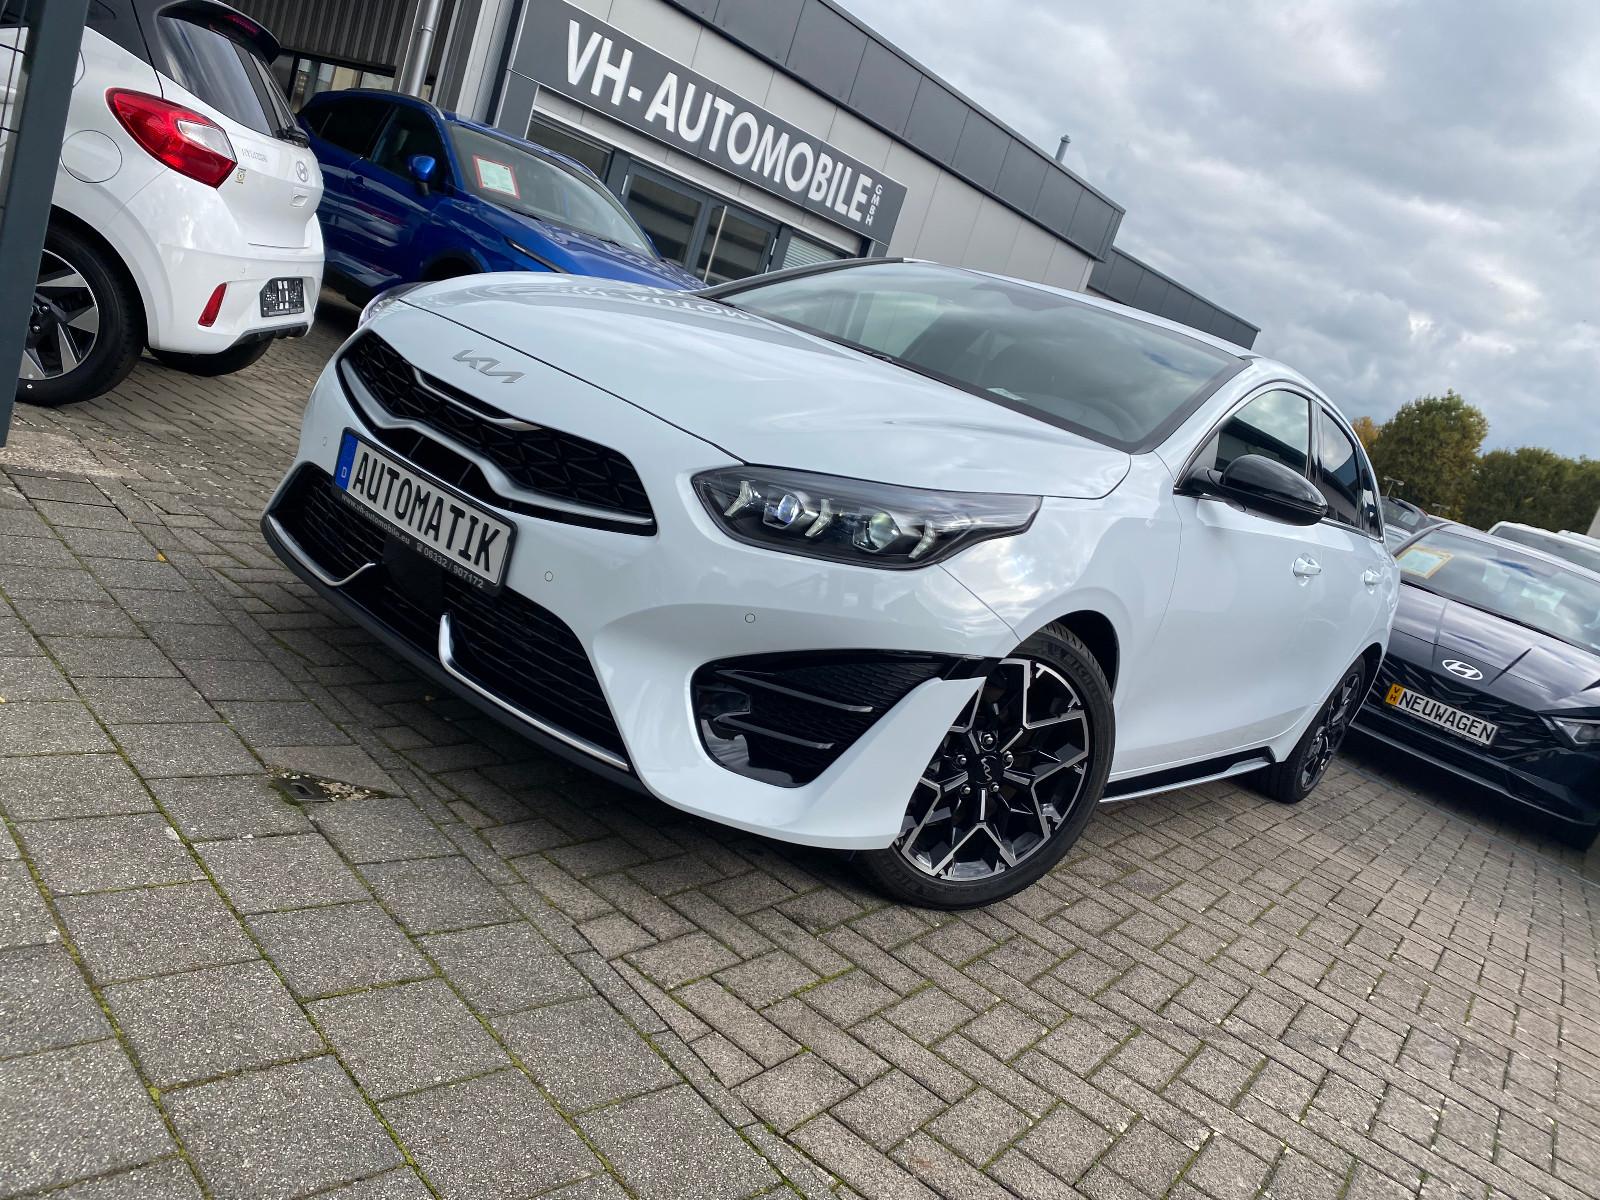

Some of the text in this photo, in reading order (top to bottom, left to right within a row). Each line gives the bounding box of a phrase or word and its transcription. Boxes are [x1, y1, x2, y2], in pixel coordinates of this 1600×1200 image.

[341, 466, 348, 479] D
[352, 451, 501, 573] AUTOMATIK
[1398, 690, 1496, 742] NEUWAGEN
